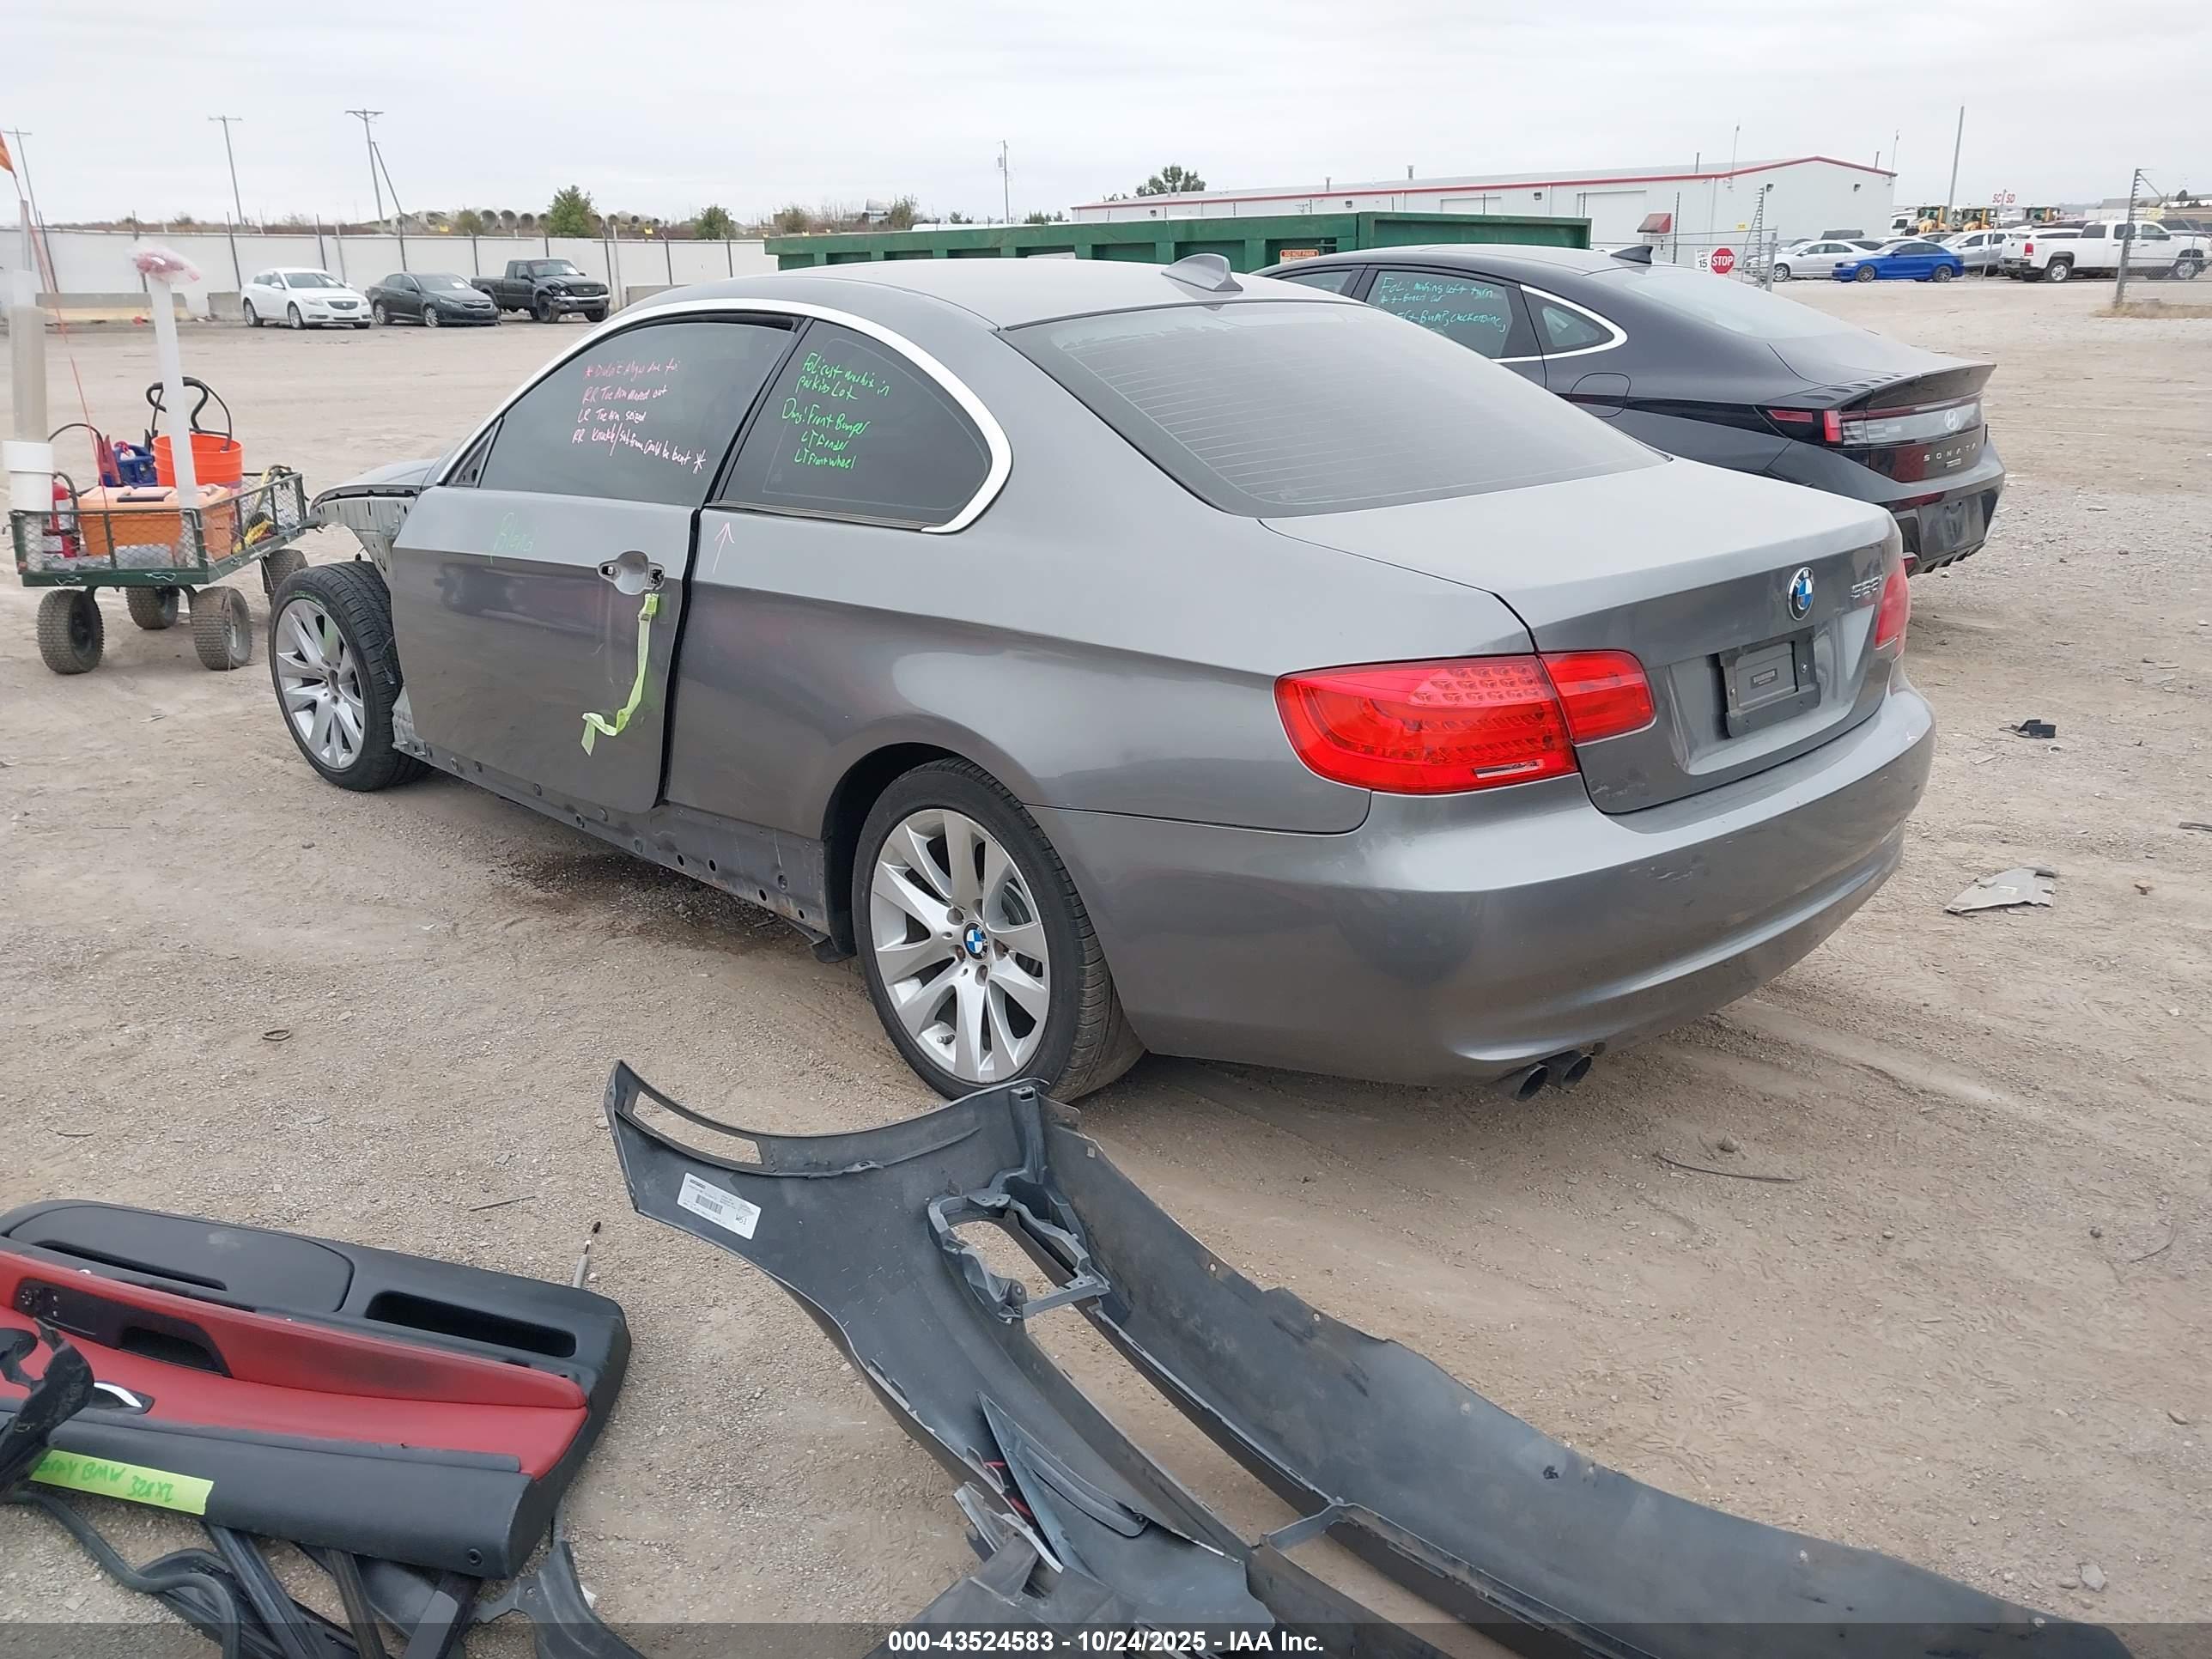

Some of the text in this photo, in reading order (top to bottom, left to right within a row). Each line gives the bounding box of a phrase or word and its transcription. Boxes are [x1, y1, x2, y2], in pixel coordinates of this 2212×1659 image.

[1698, 258, 1708, 268] 15
[1711, 255, 1734, 266] STOP
[1923, 442, 1976, 462] SONATA
[82, 1461, 126, 1483] BMW
